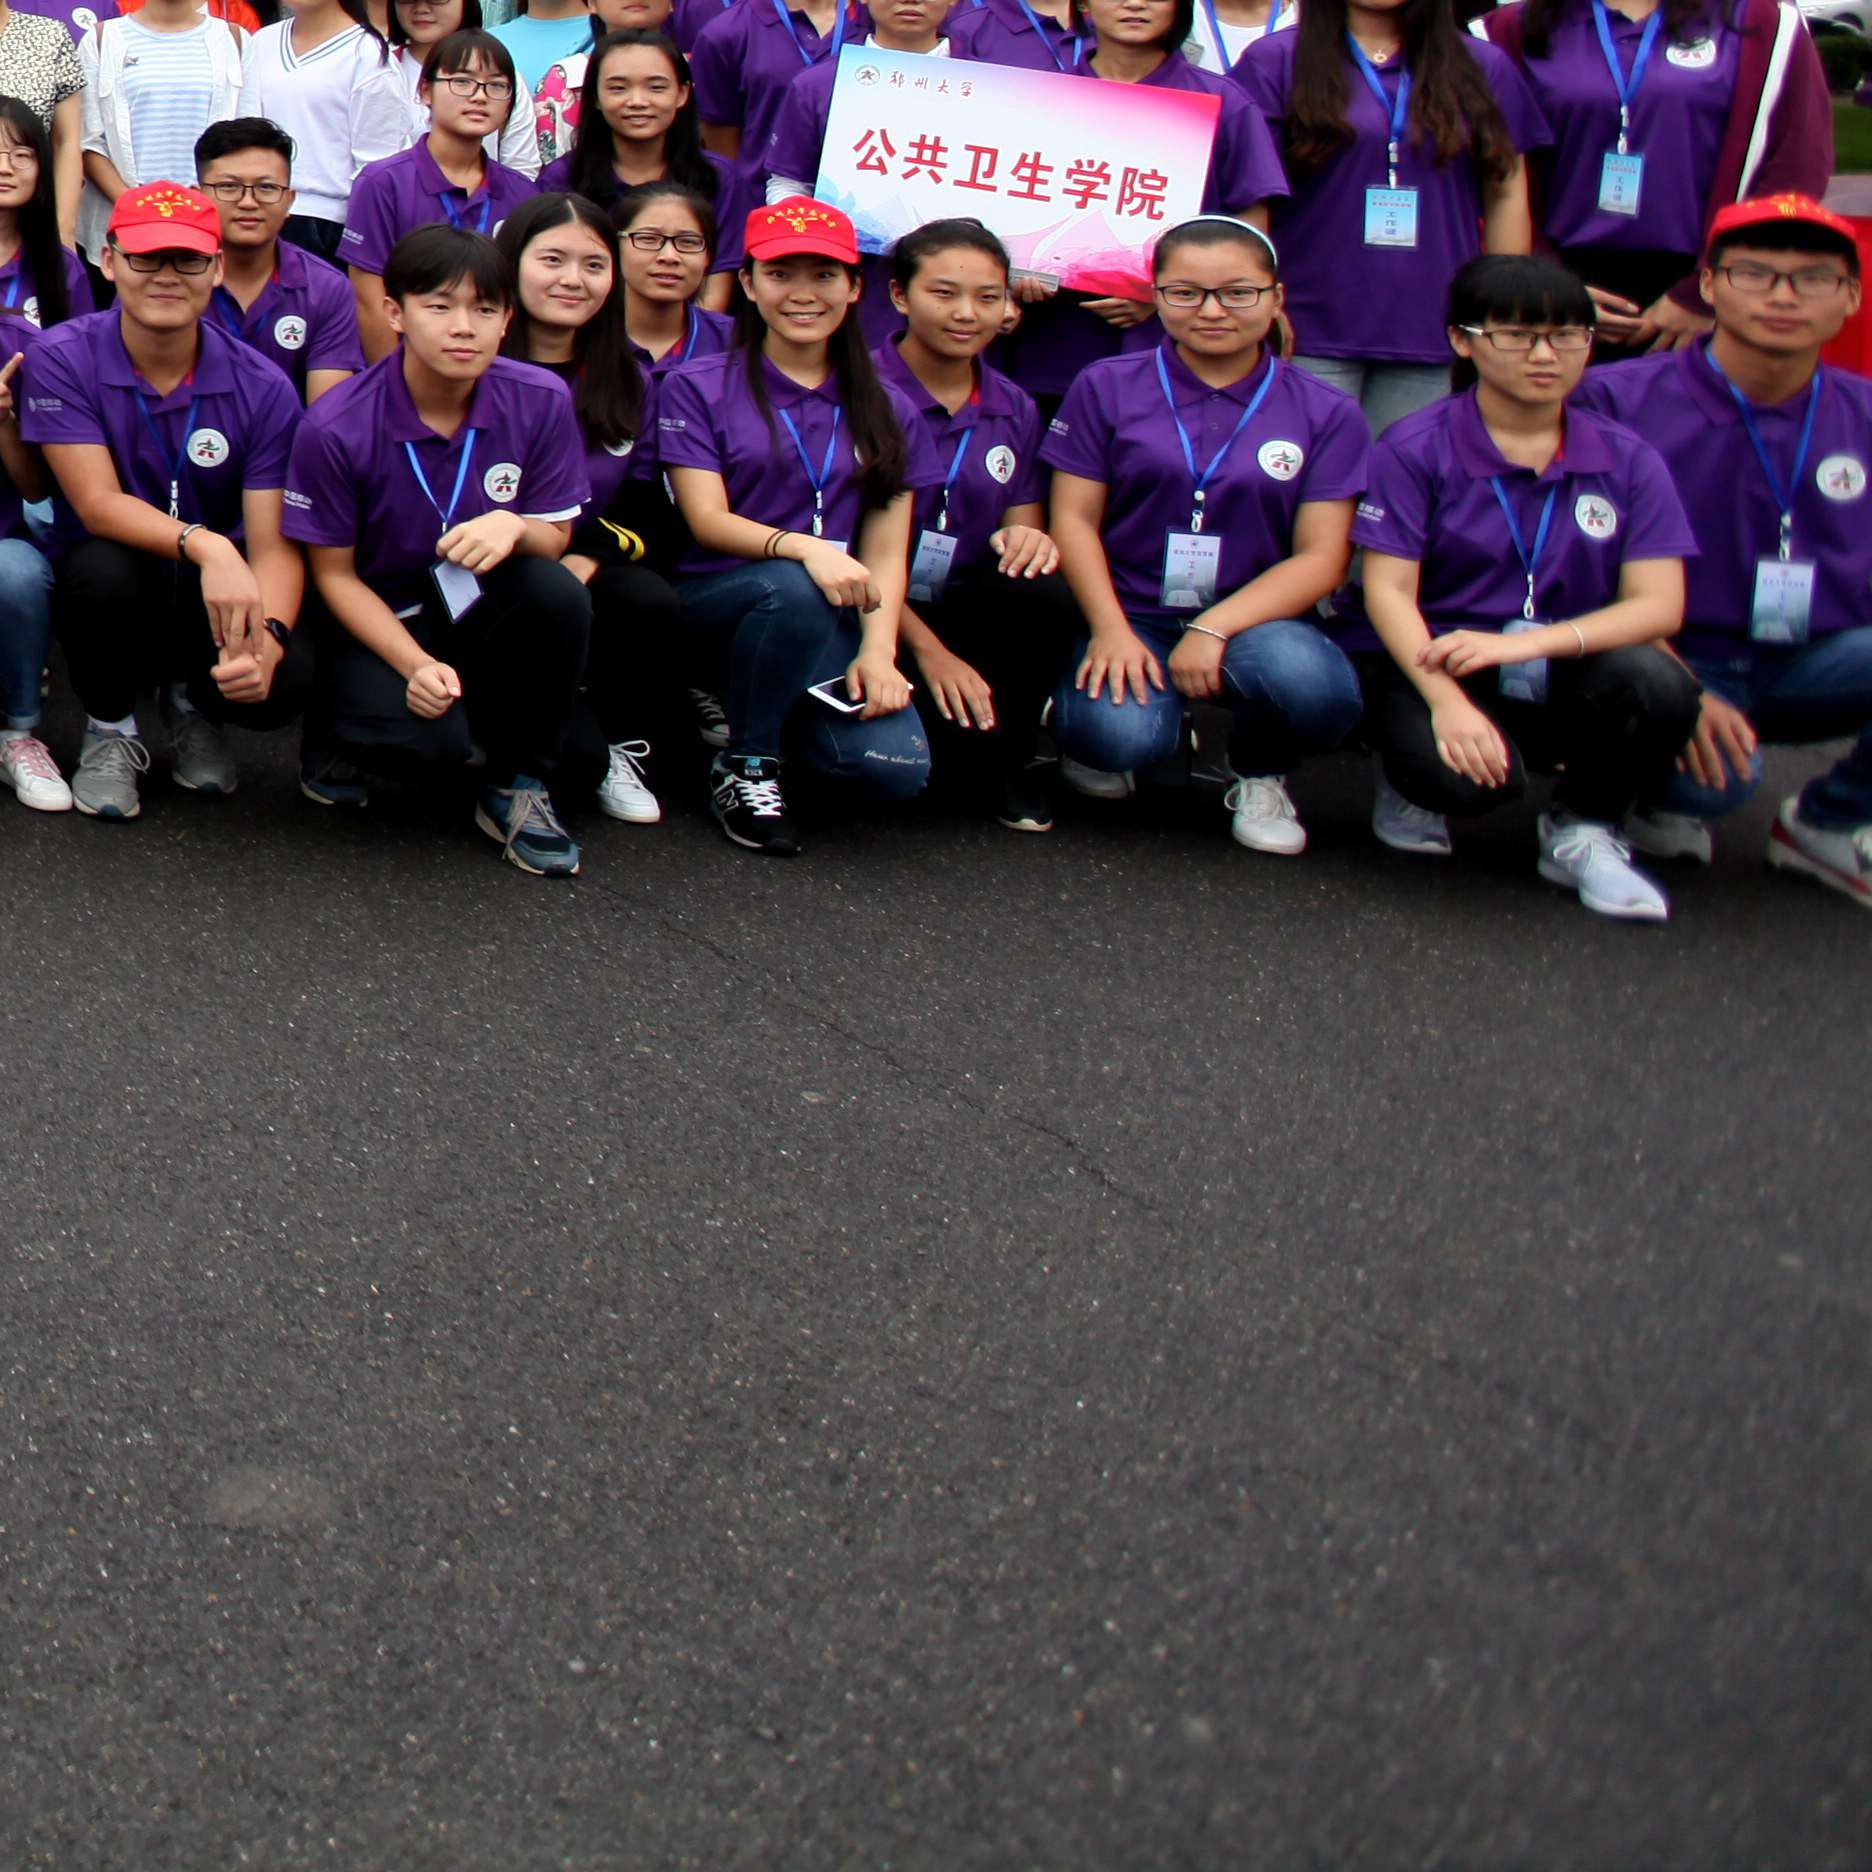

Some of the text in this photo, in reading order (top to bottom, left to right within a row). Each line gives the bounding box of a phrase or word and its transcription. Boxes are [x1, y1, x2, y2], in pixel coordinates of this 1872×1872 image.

[852, 128, 1170, 221] 公共卫生学院
